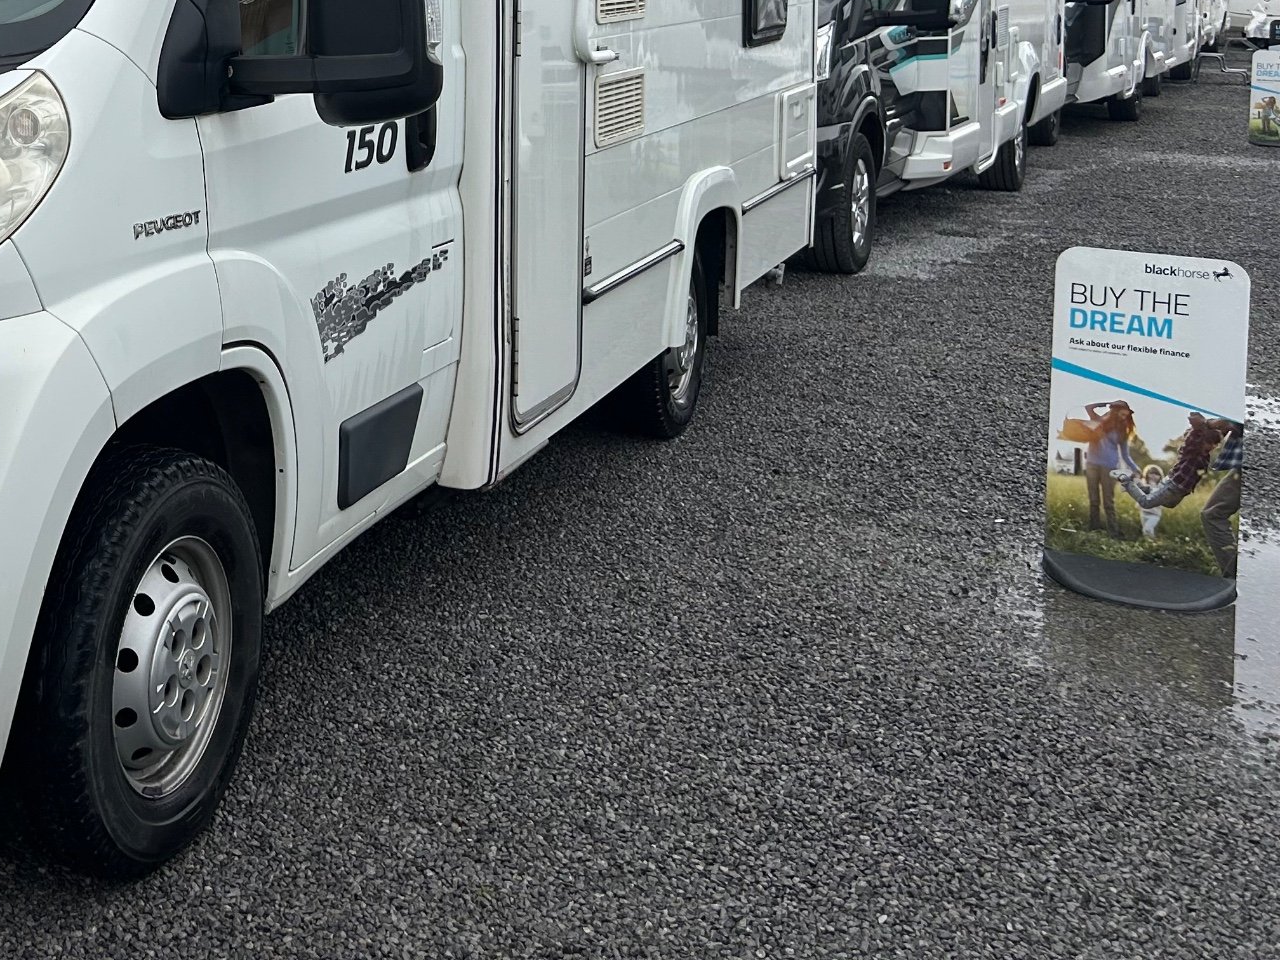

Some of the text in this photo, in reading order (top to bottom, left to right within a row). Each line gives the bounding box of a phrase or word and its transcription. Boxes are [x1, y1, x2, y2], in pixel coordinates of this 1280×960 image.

[344, 121, 398, 174] 150
[133, 210, 201, 240] PEUGEOT
[1070, 282, 1191, 316] BUY THE
[1069, 307, 1173, 339] DREAM
[1069, 337, 1084, 346] Ask
[1086, 340, 1109, 349] about
[1127, 344, 1158, 355] flexible
[1159, 348, 1191, 359] finance
